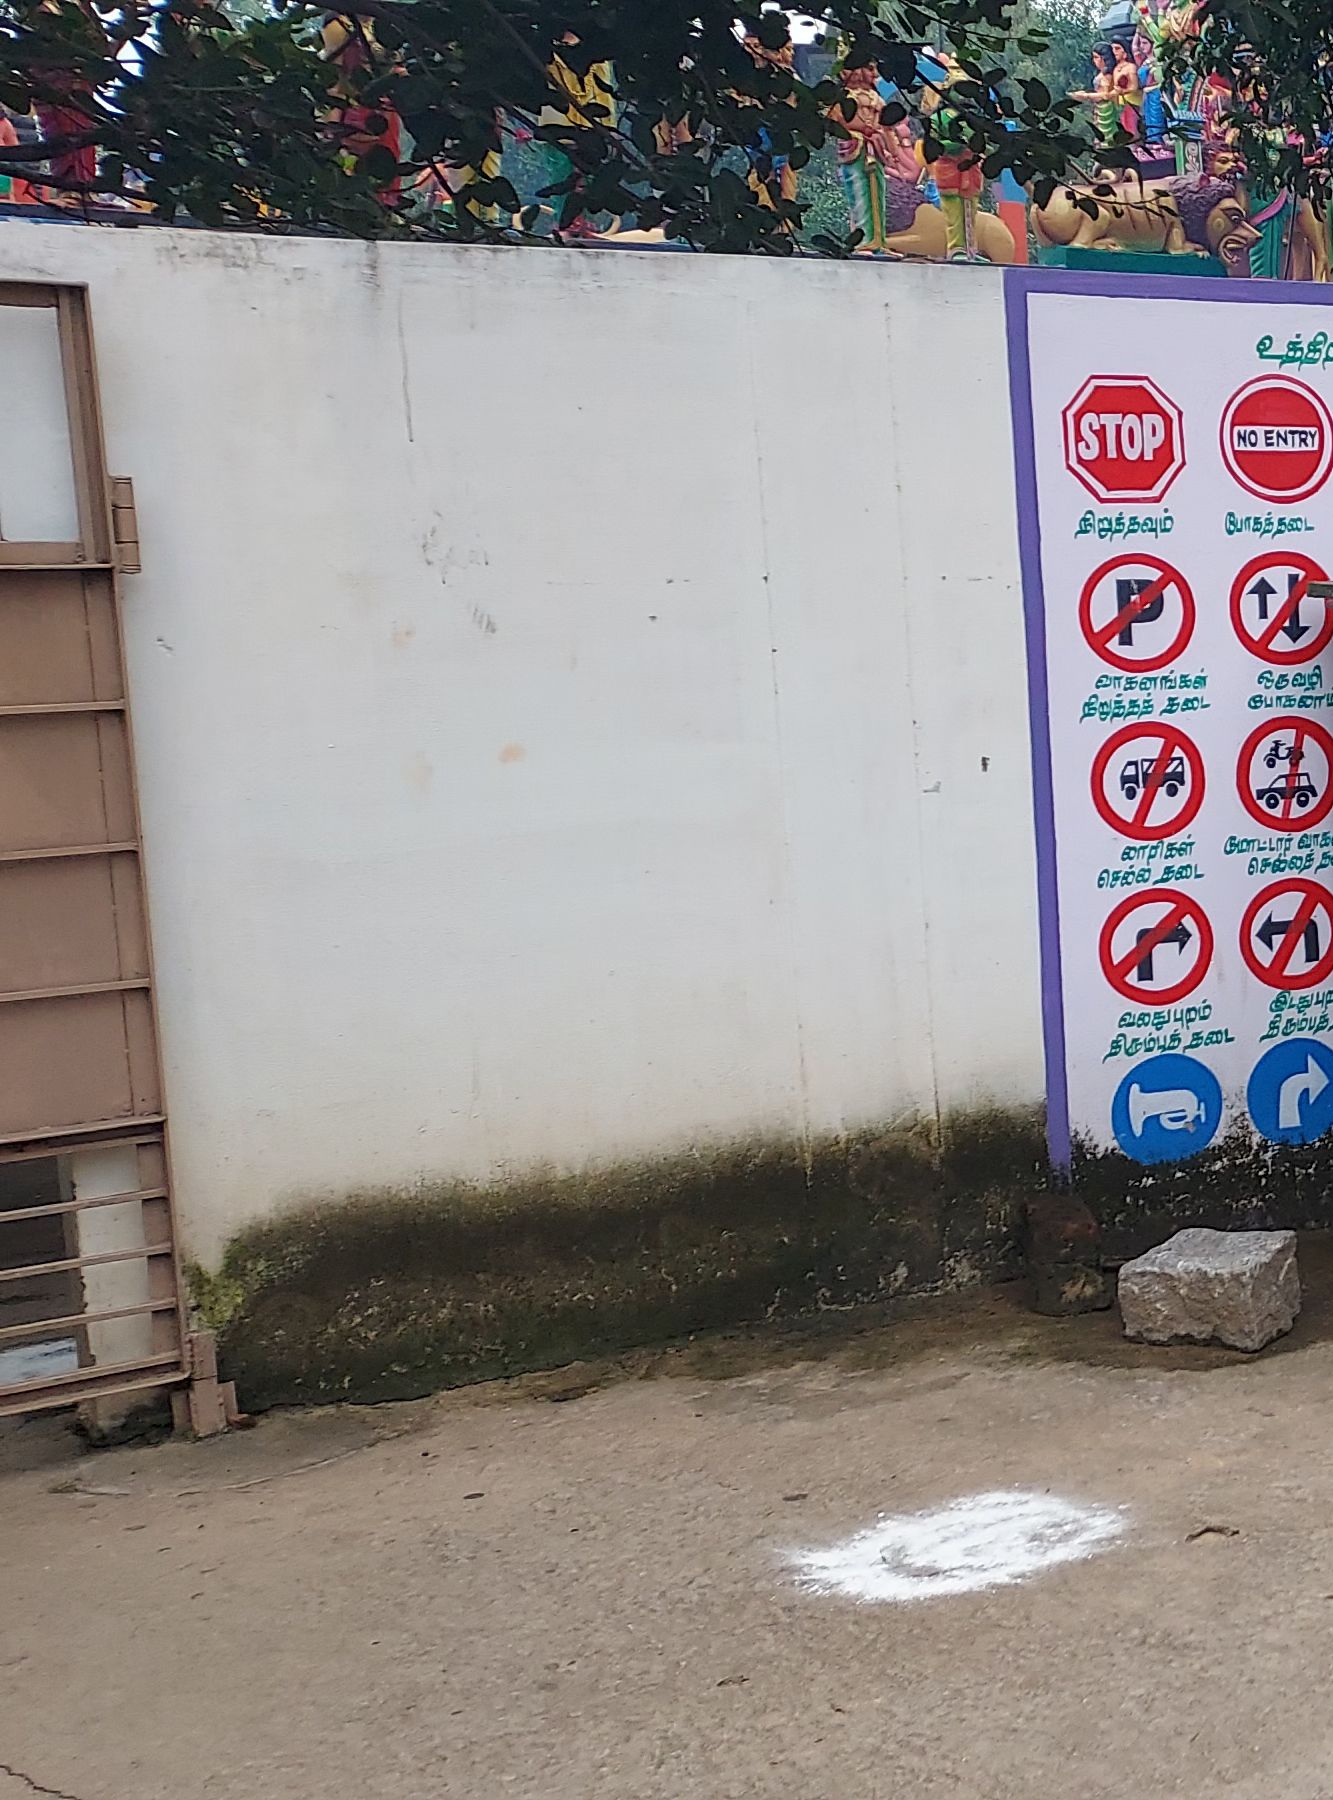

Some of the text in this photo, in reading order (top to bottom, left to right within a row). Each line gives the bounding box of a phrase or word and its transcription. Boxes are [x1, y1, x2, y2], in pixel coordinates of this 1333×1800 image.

[1078, 412, 1165, 461] STOP
[1236, 429, 1318, 449] NO ENTRY
[1074, 507, 1175, 542] நிறுத்தவும்
[1094, 668, 1208, 692] வாகனங்கள்
[1159, 694, 1211, 717] தடை
[1120, 833, 1196, 863] லாரிகள்
[1096, 863, 1205, 889] செல்ல தடை
[1182, 1027, 1236, 1053] தடை
